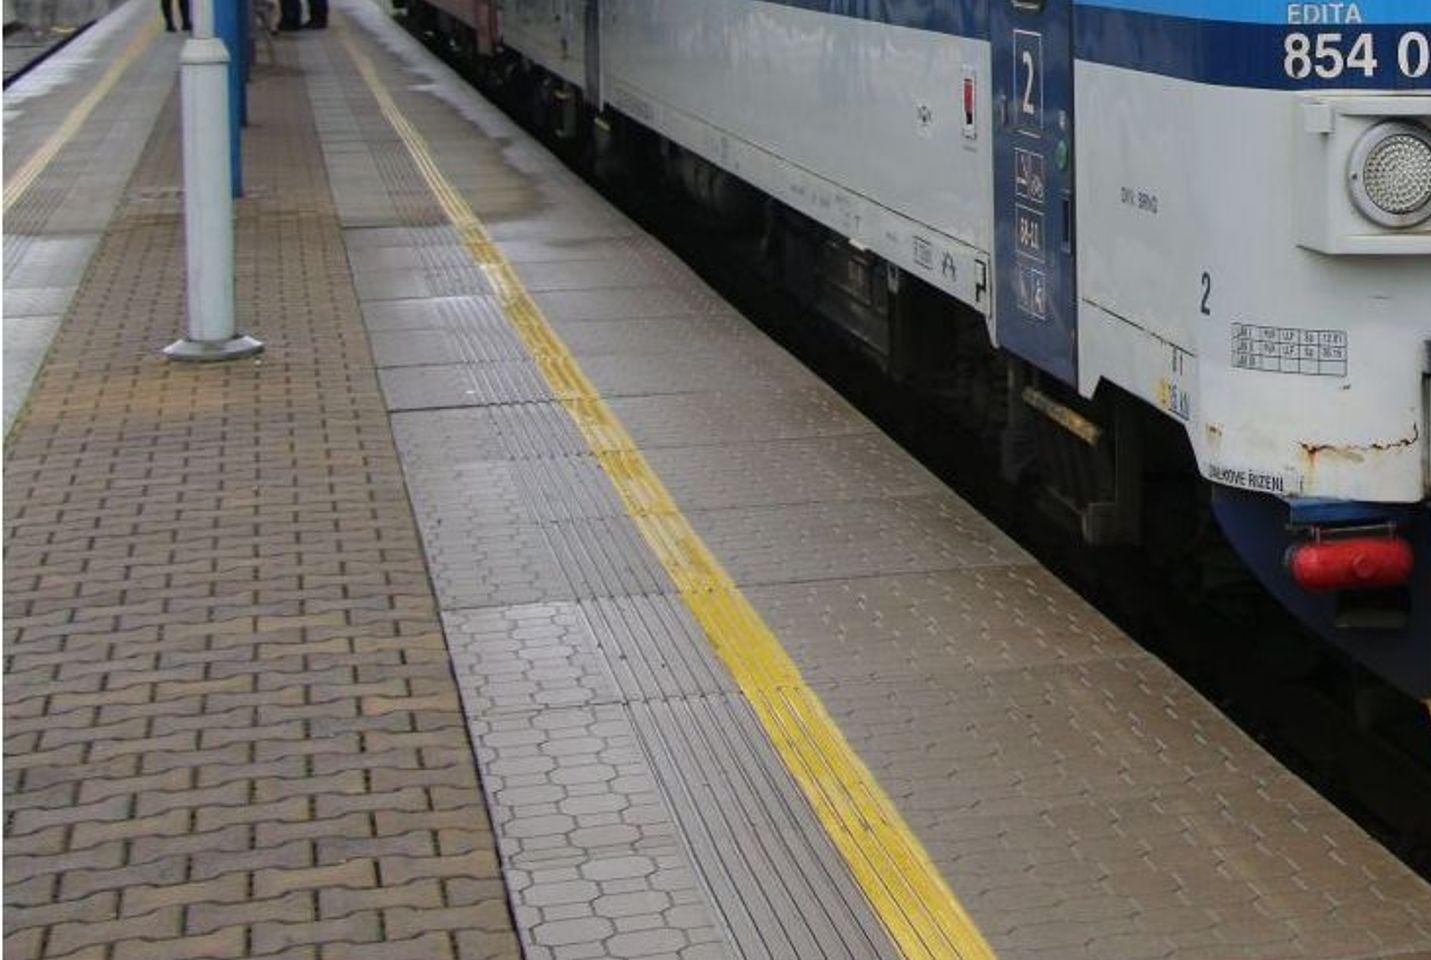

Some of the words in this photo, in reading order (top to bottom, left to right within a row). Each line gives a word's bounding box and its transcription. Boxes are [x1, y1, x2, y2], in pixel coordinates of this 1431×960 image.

[1287, 2, 1362, 25] EDITA
[1283, 32, 1378, 79] 854
[1022, 51, 1035, 114] 2
[1201, 271, 1211, 316] 2
